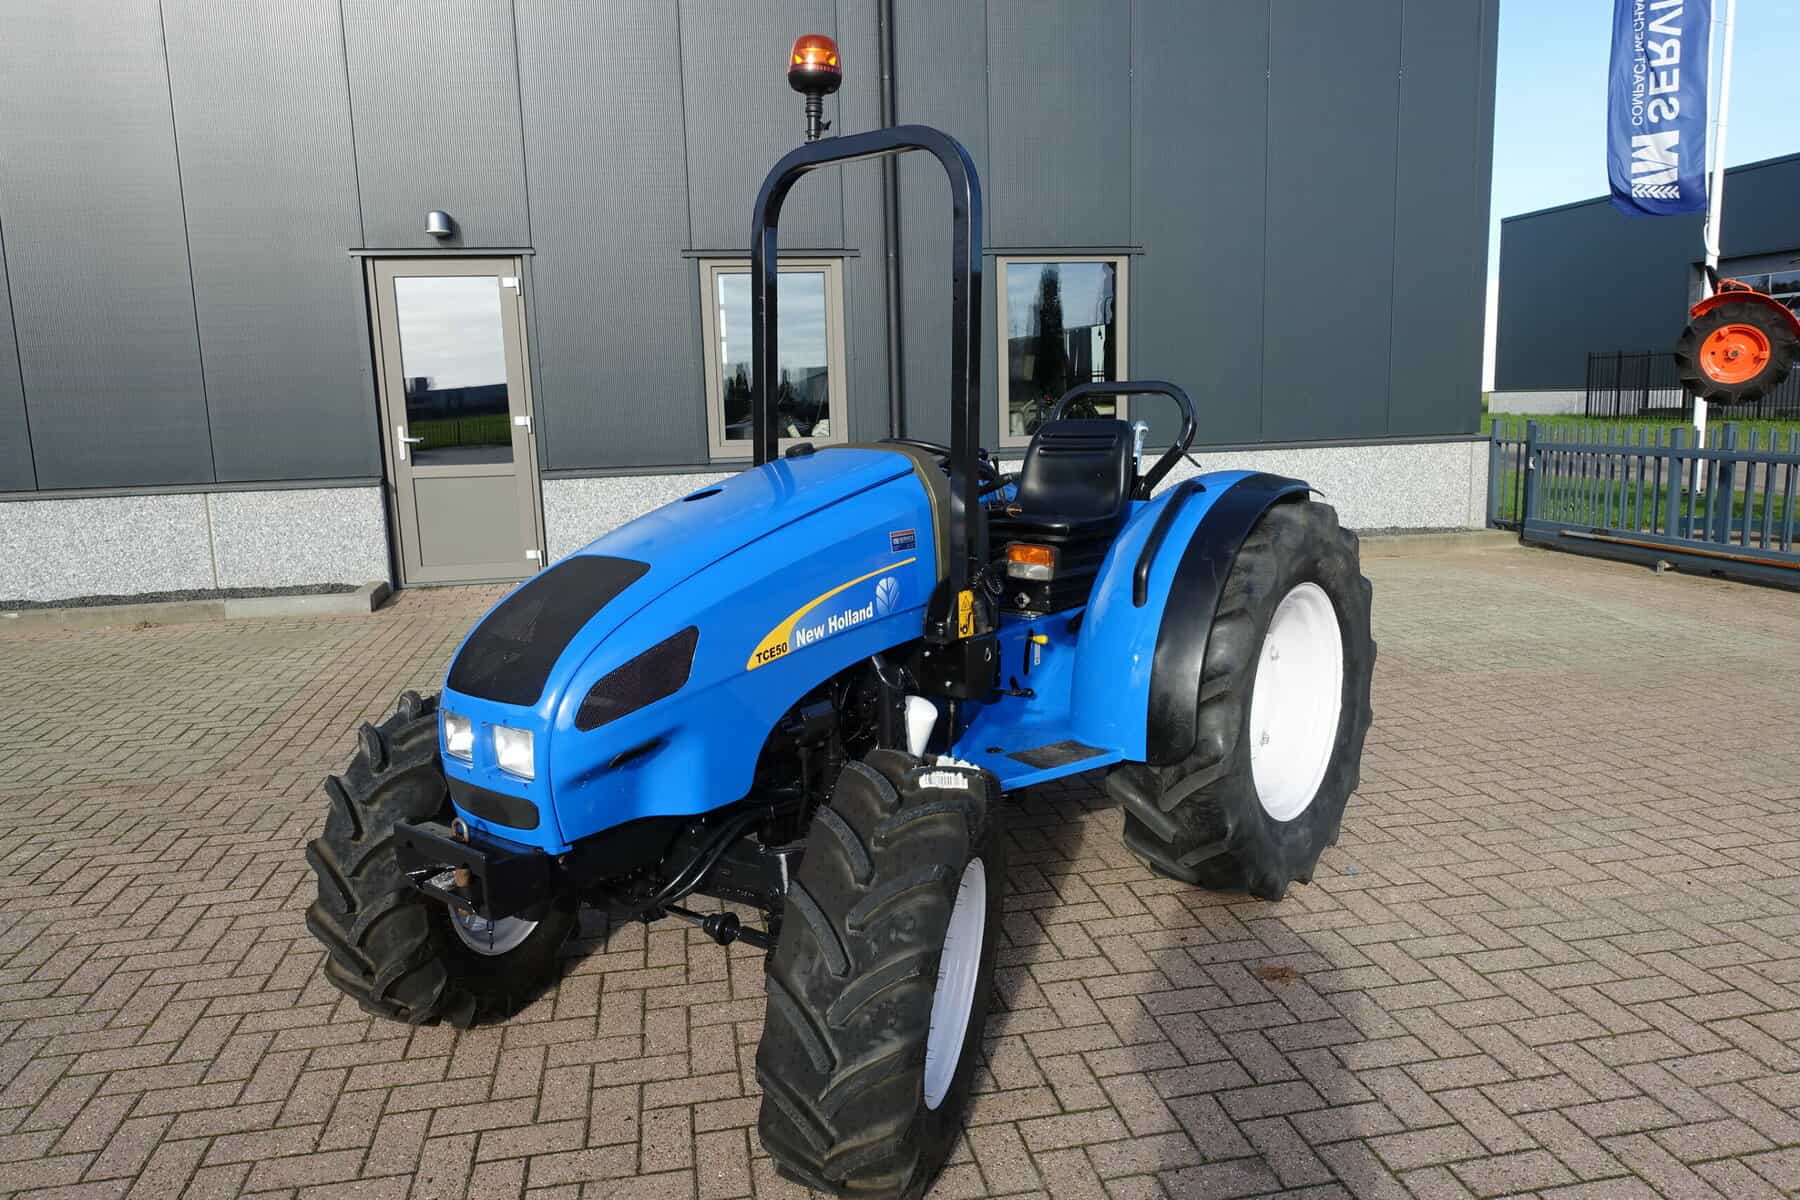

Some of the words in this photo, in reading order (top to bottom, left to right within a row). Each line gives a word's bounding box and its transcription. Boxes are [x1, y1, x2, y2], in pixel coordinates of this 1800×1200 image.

[795, 624, 825, 648] New
[828, 601, 874, 634] Holland
[756, 642, 788, 664] TCE50
